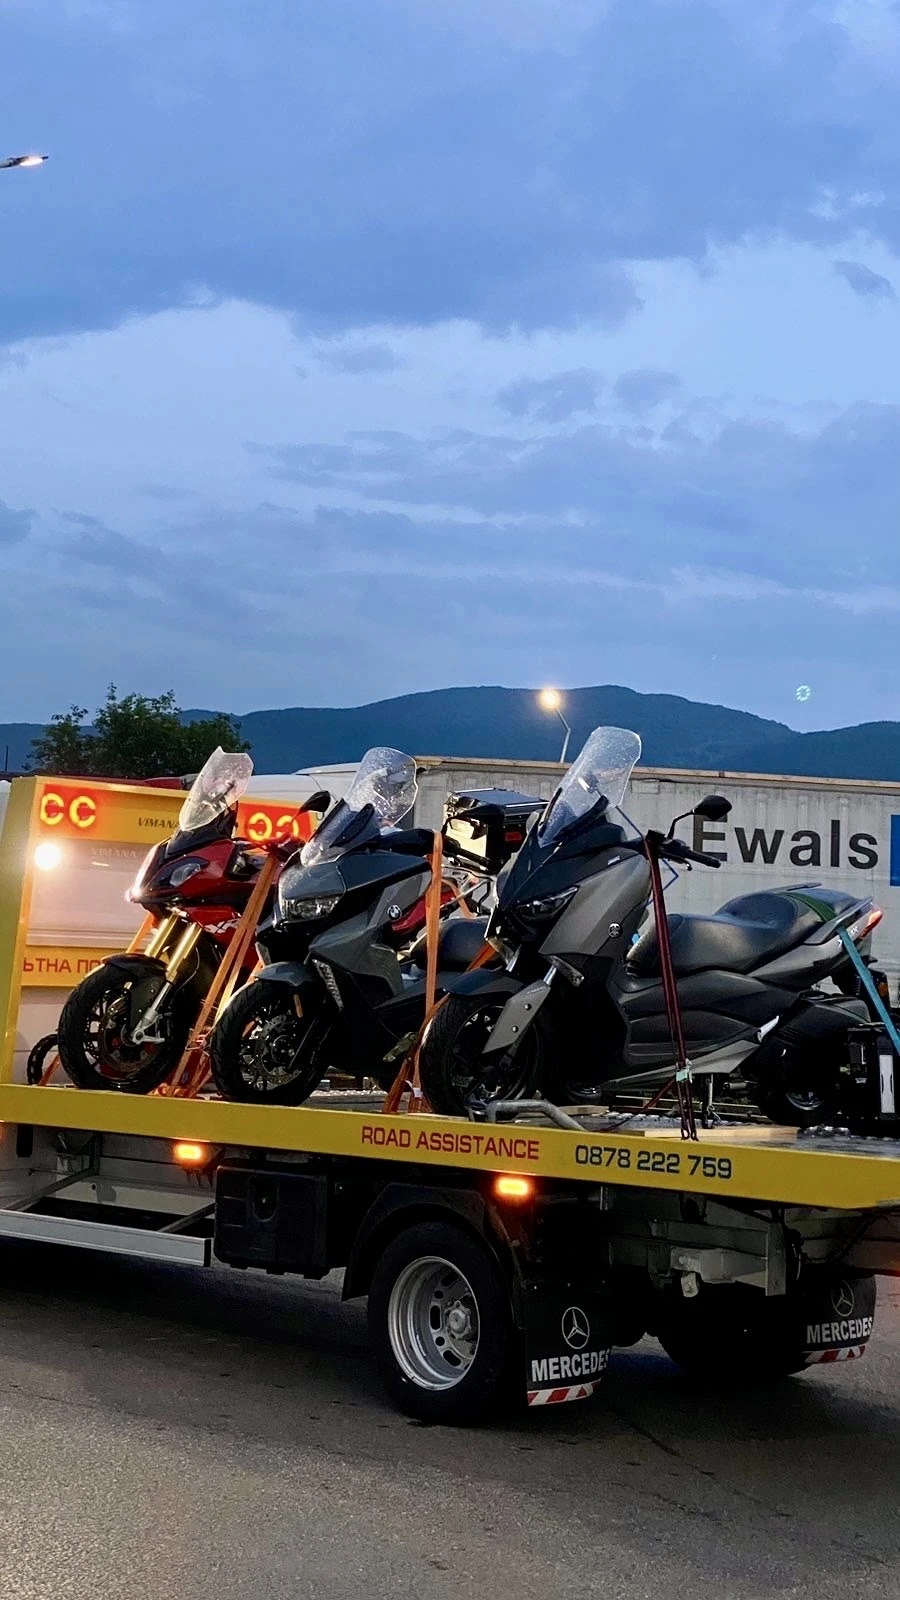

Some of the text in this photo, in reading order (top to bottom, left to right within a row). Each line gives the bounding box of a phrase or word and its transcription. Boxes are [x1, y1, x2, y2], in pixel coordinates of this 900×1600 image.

[693, 811, 879, 870] Ewals
[361, 1125, 540, 1160] ROAD ASSISTANCE
[575, 1144, 732, 1179] 0878 222 759
